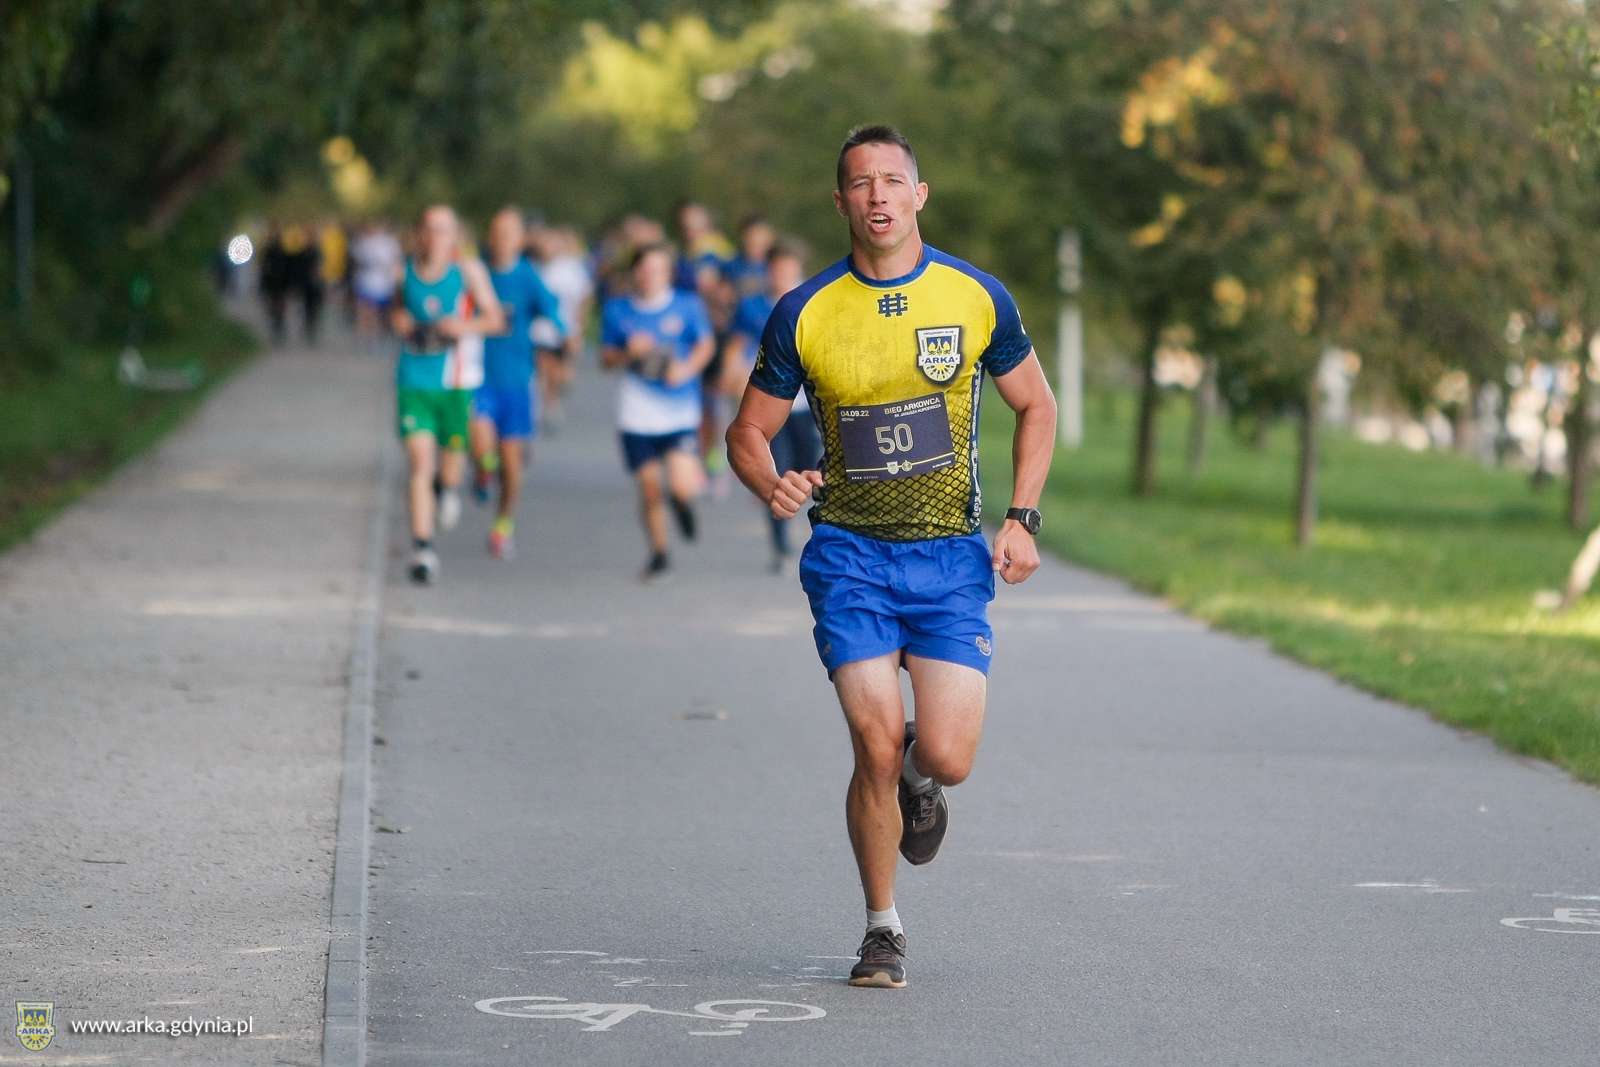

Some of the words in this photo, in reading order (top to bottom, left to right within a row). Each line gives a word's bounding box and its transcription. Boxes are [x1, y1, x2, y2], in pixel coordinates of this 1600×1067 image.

[924, 356, 955, 364] ARKA
[884, 405, 902, 415] BIEG
[903, 397, 940, 411] ARKOWCA
[875, 423, 914, 454] 50
